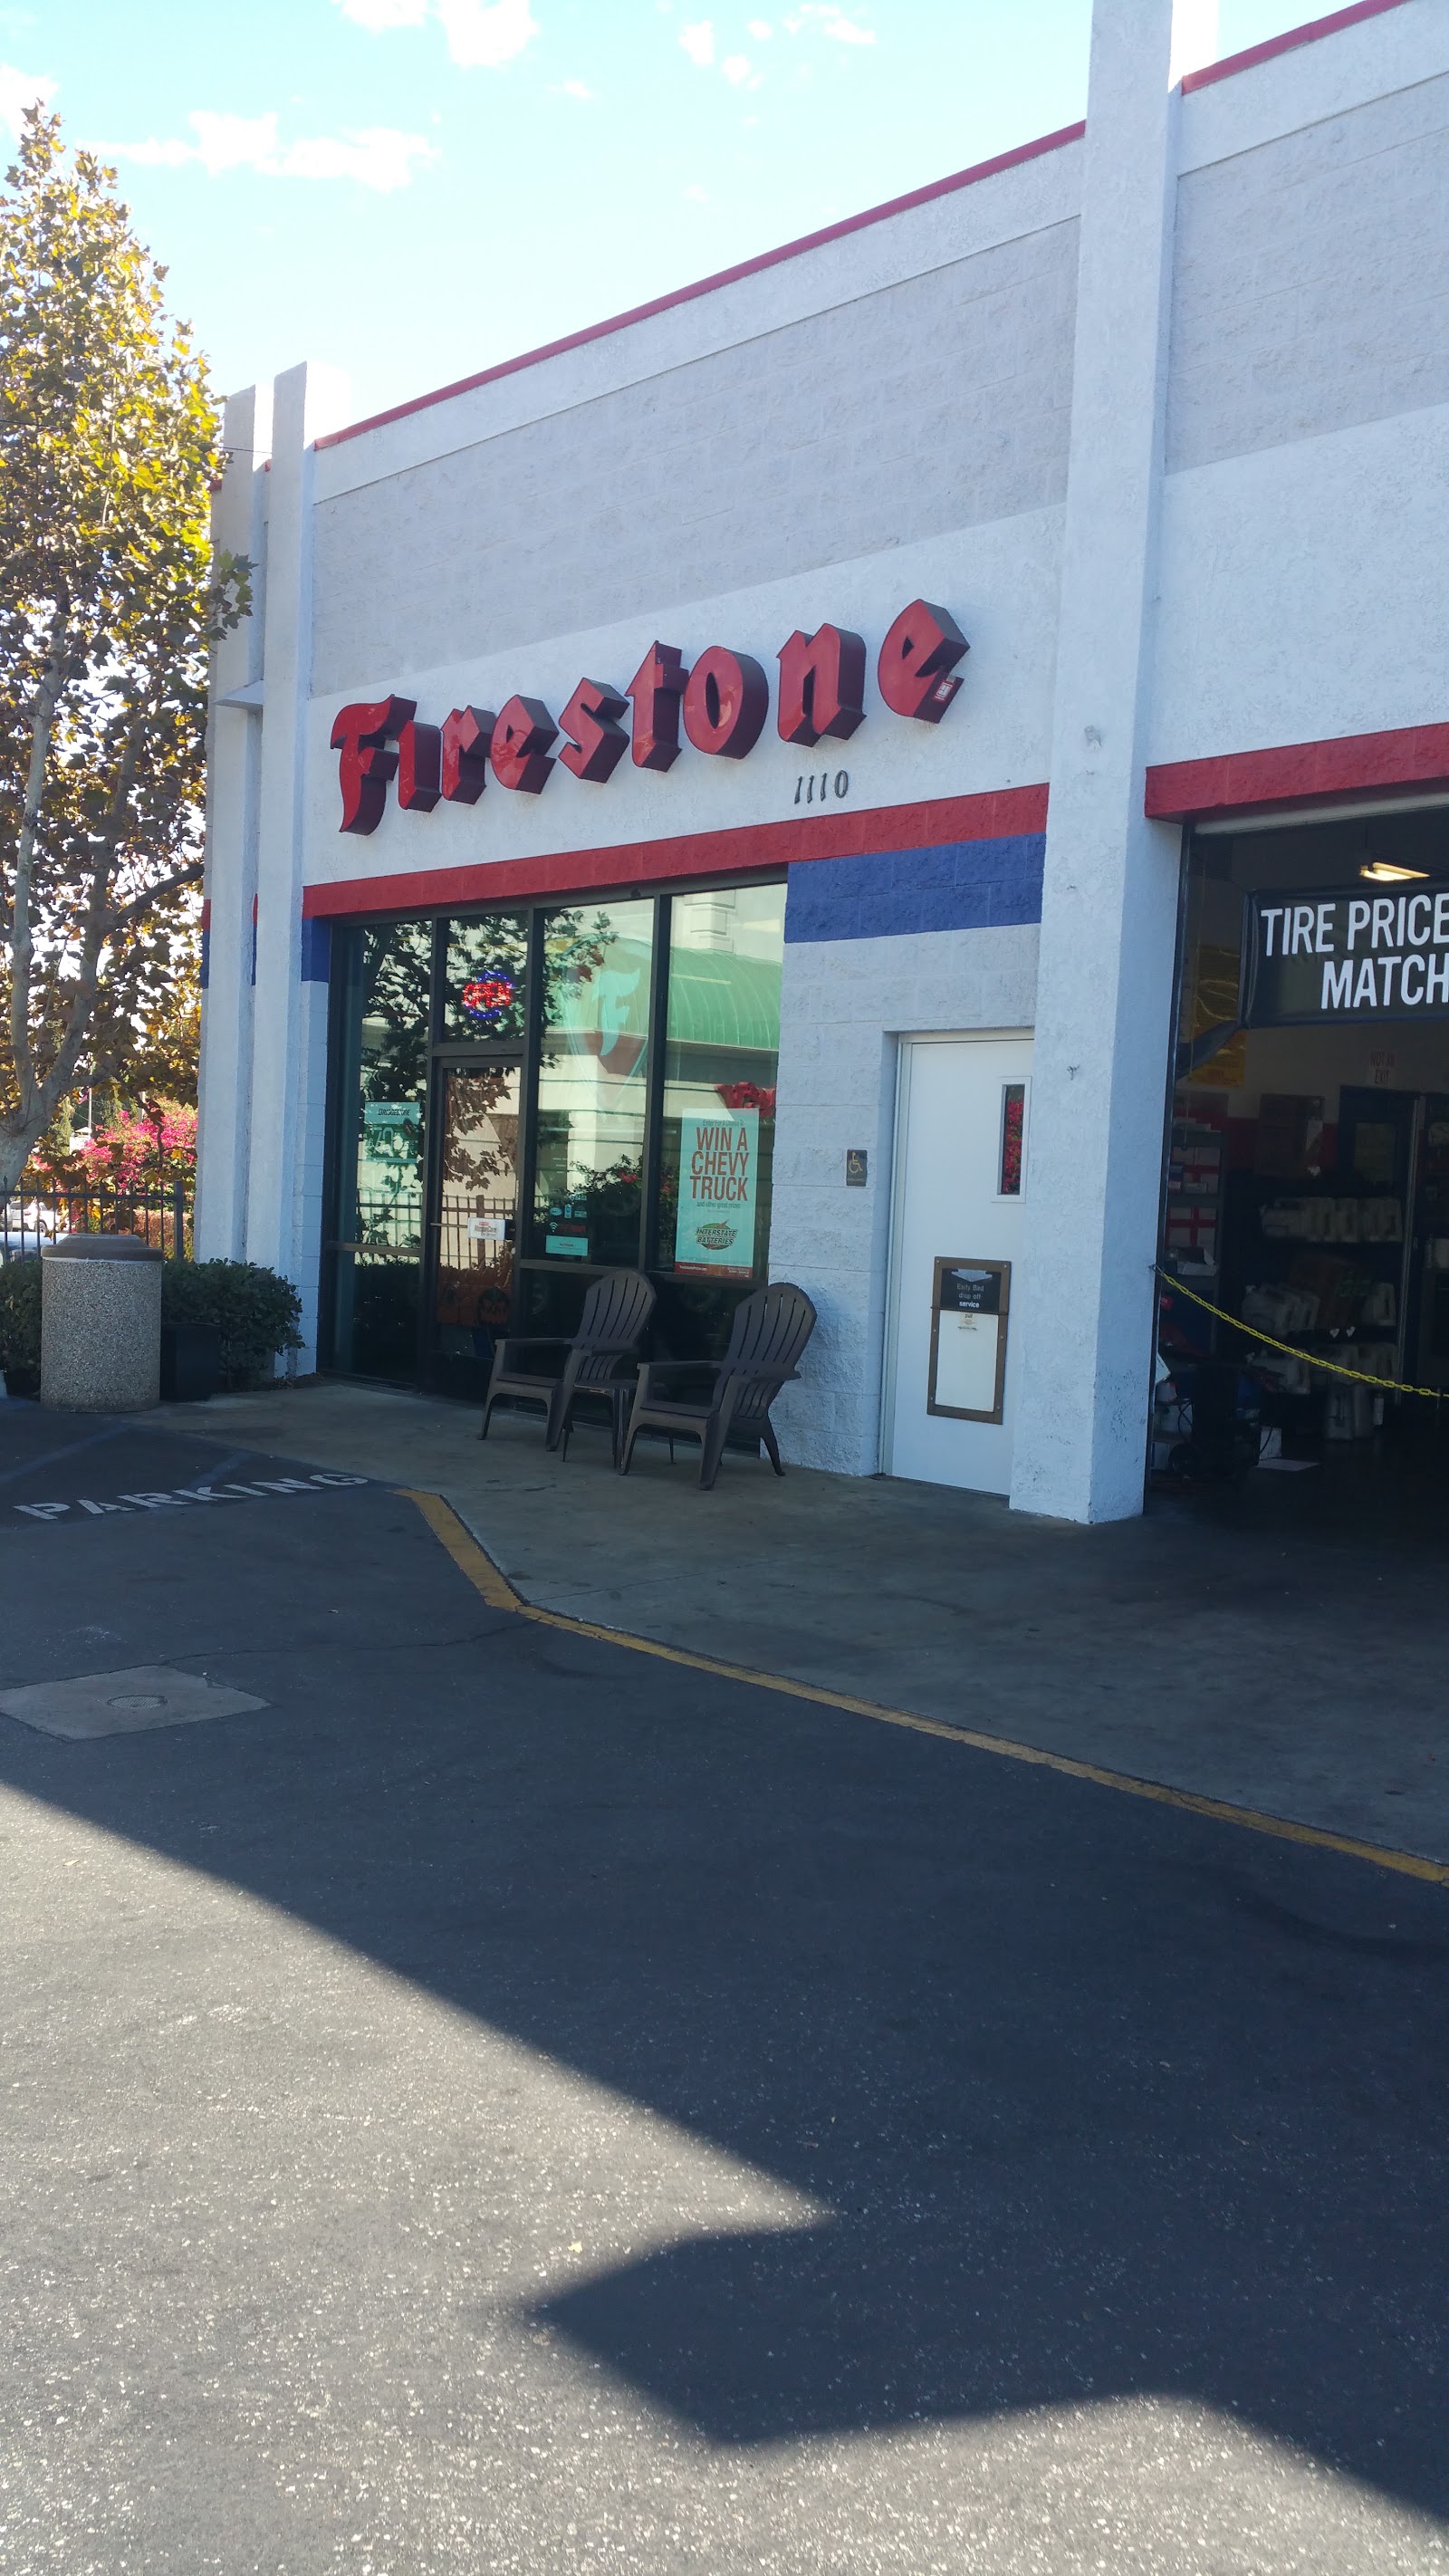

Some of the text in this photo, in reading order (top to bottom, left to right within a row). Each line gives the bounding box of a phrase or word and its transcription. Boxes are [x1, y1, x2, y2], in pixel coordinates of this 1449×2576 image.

[331, 599, 971, 836] Firestone
[794, 769, 849, 804] 1110
[1261, 903, 1336, 956] TIRE
[464, 982, 510, 1006] OPEN
[696, 1127, 748, 1151] WIN A
[691, 1151, 749, 1176] CHEVY
[690, 1176, 748, 1202] TRUCK
[696, 1228, 737, 1237] INTERSTATE
[696, 1236, 734, 1245] BATTERIES
[13, 1473, 369, 1521] PARKING
